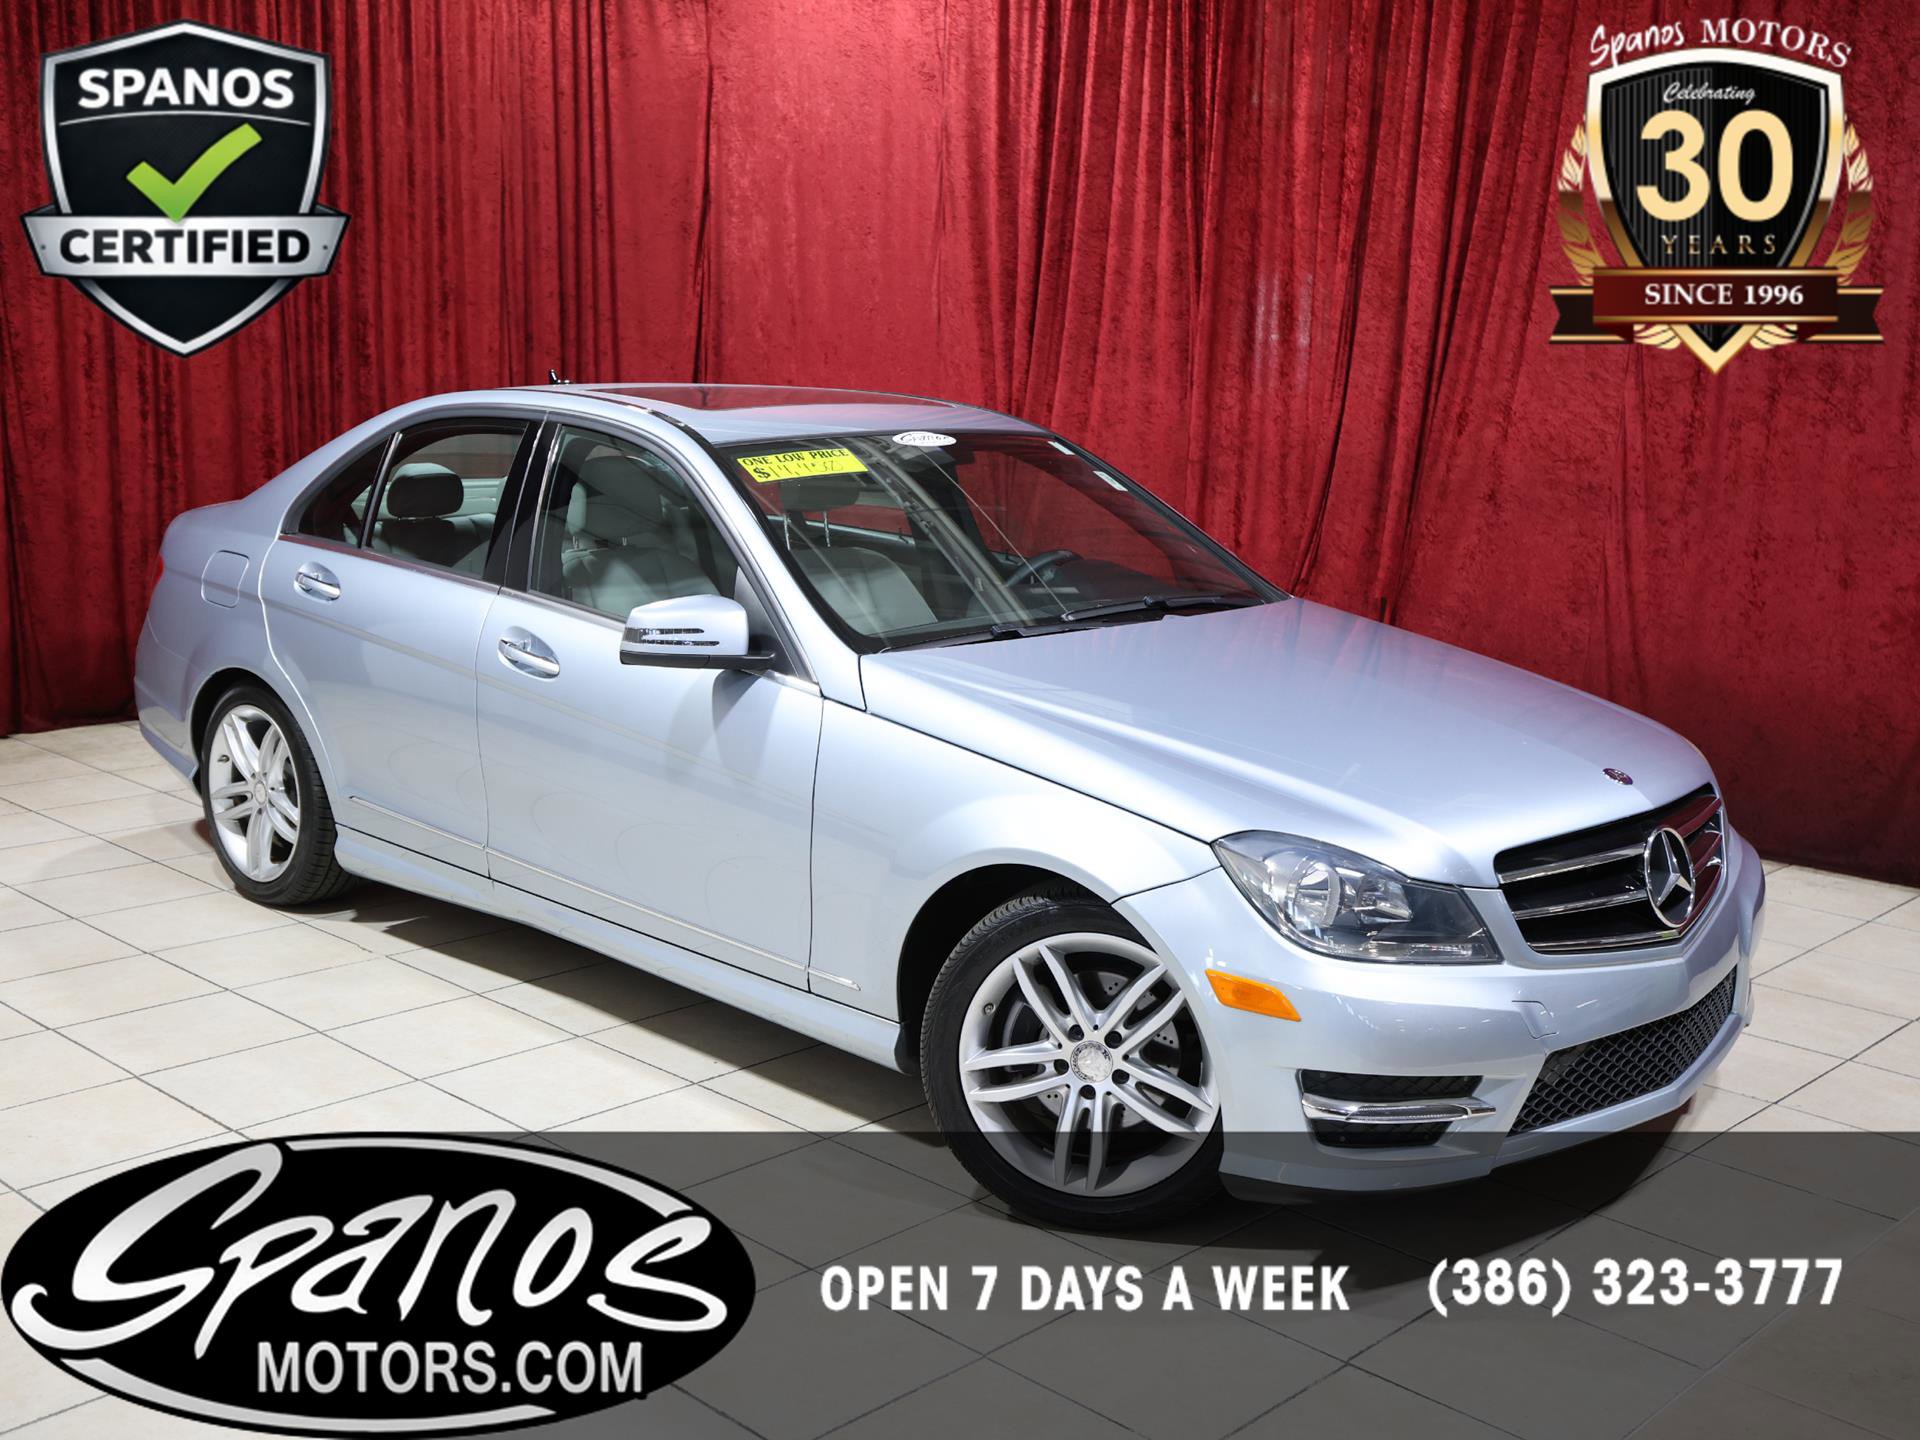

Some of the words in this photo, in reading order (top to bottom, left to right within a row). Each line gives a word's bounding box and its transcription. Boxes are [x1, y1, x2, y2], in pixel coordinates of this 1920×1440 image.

[742, 457, 772, 467] ONE
[775, 452, 805, 464] LOW
[809, 449, 850, 460] PRICE
